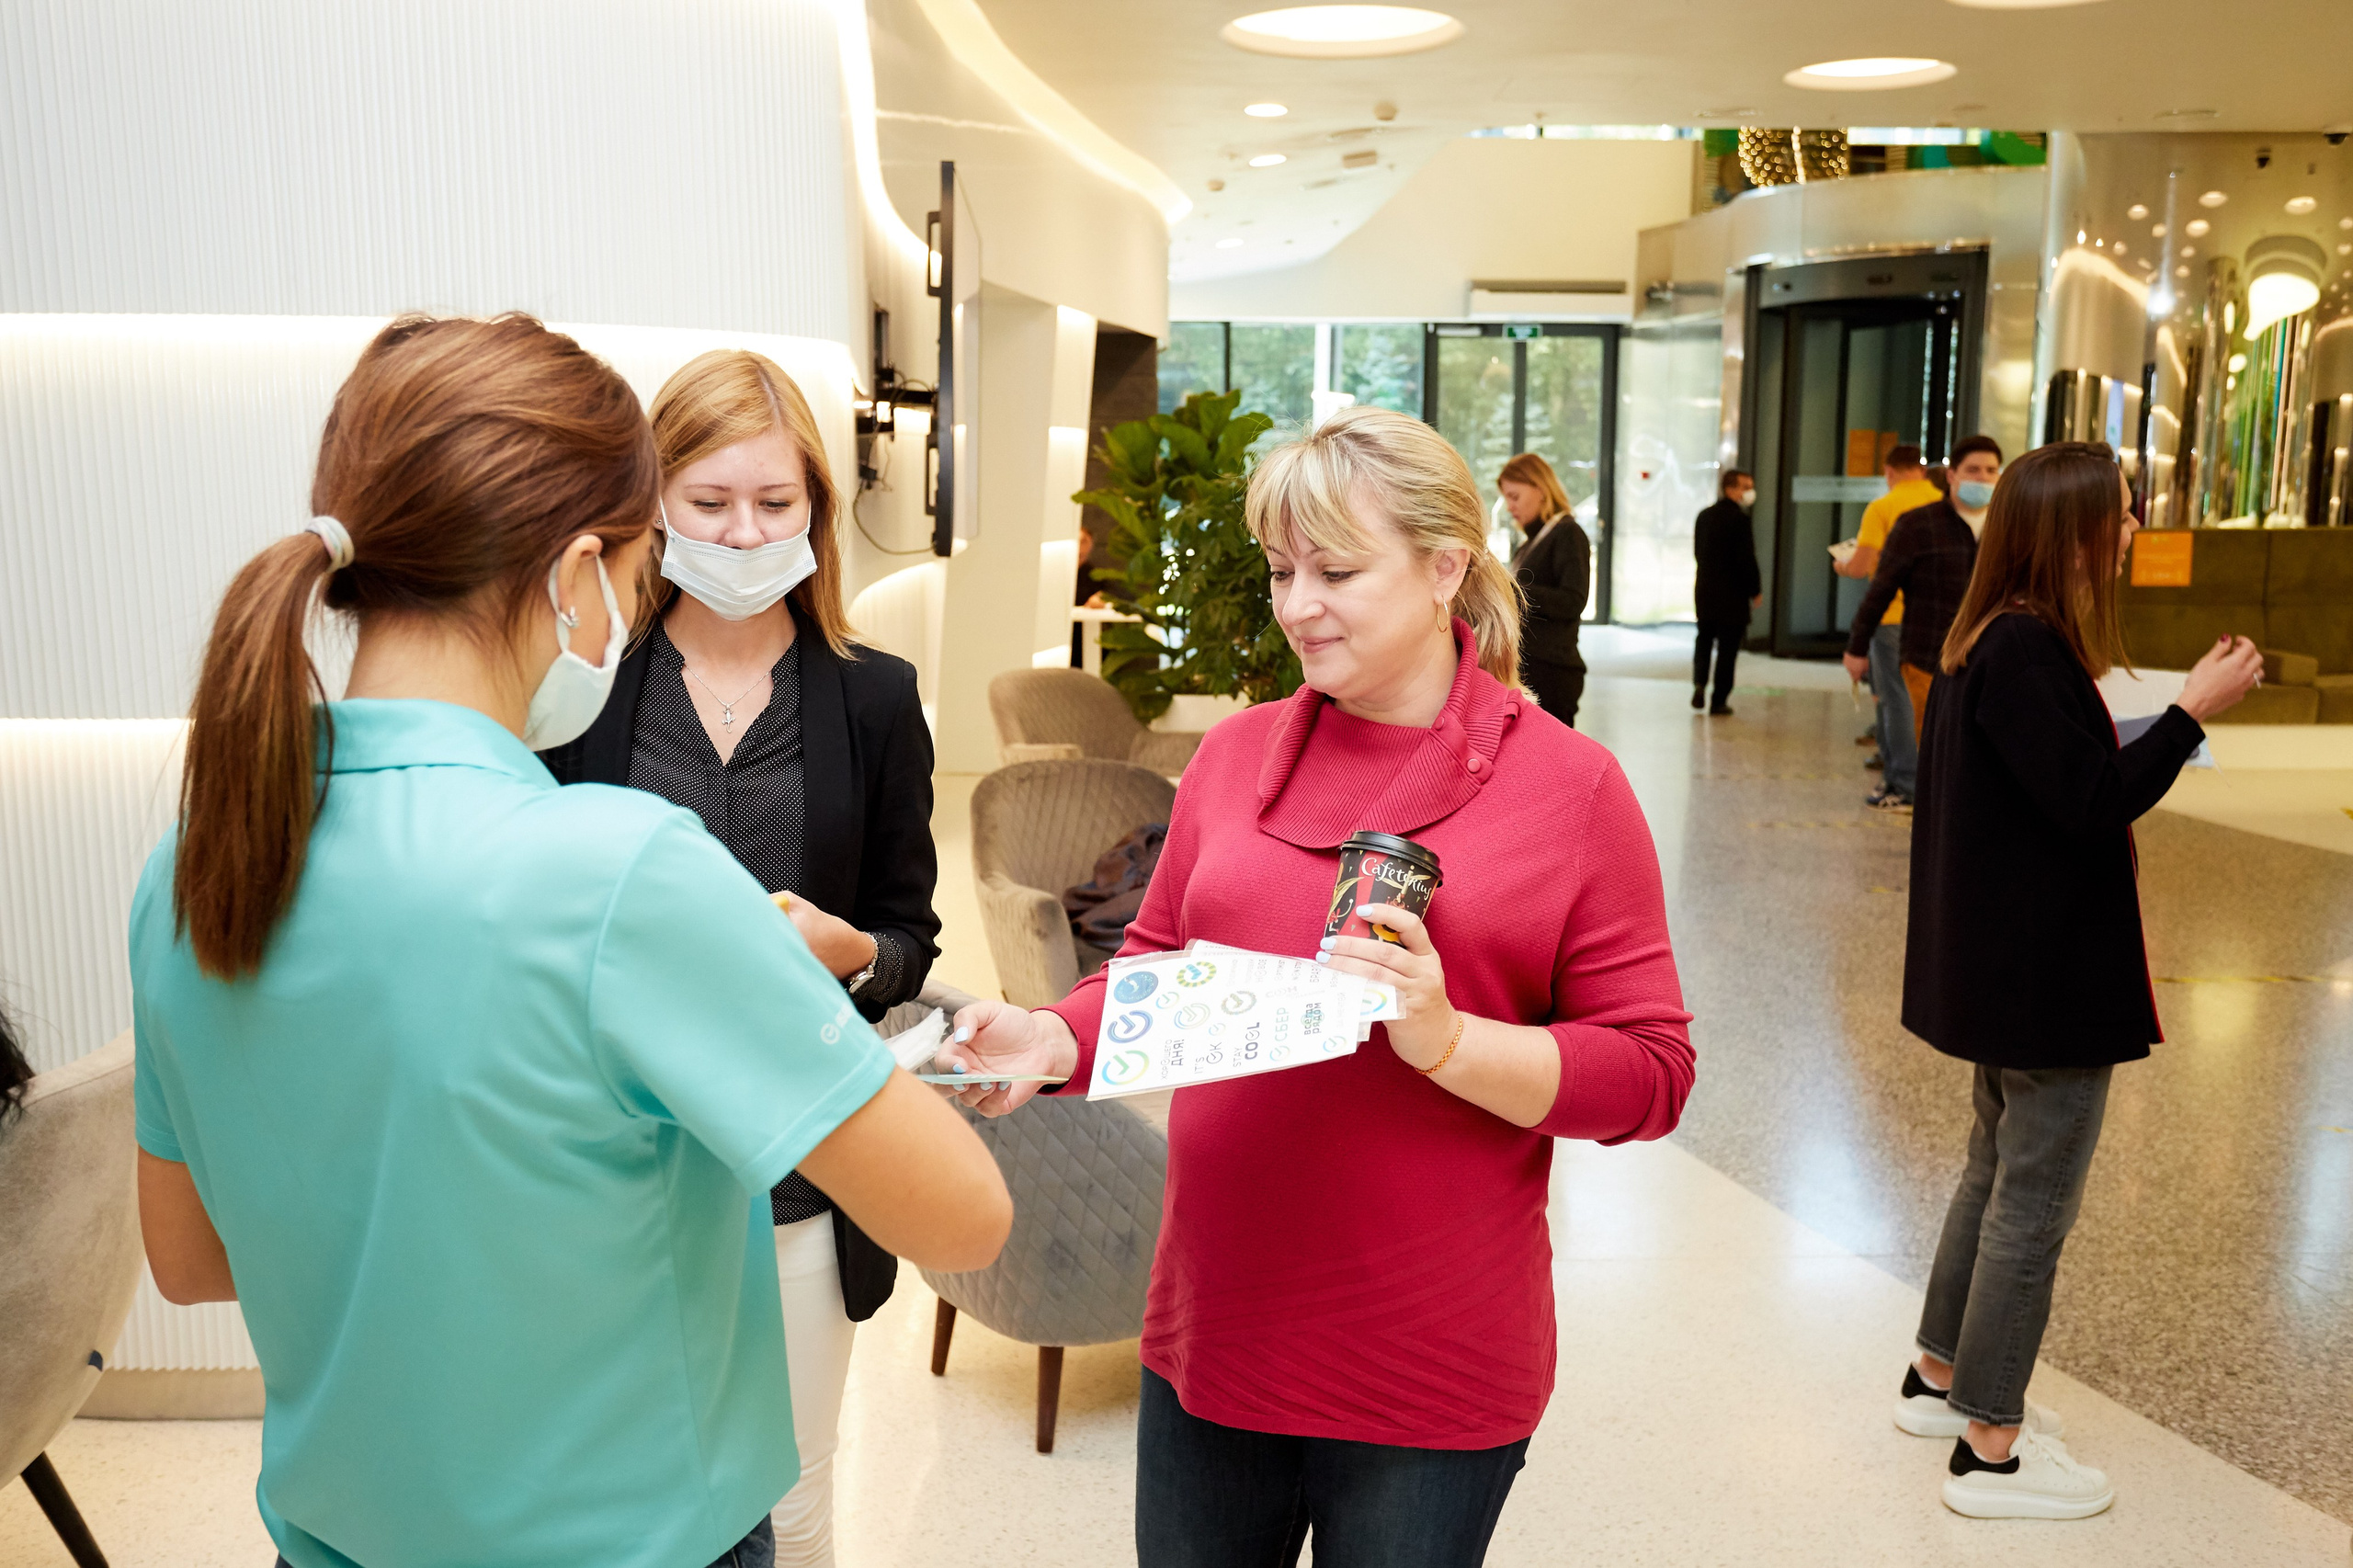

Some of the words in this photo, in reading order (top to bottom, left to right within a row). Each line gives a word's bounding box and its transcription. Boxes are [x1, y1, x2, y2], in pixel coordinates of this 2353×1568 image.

[1275, 1007, 1290, 1041] СБЕР
[1304, 1003, 1313, 1035] всегда
[1313, 1002, 1322, 1034] рядом
[1171, 1039, 1185, 1066] ДНЯ!
[1245, 1022, 1260, 1060] COOL
[1233, 1047, 1242, 1068] STAY
